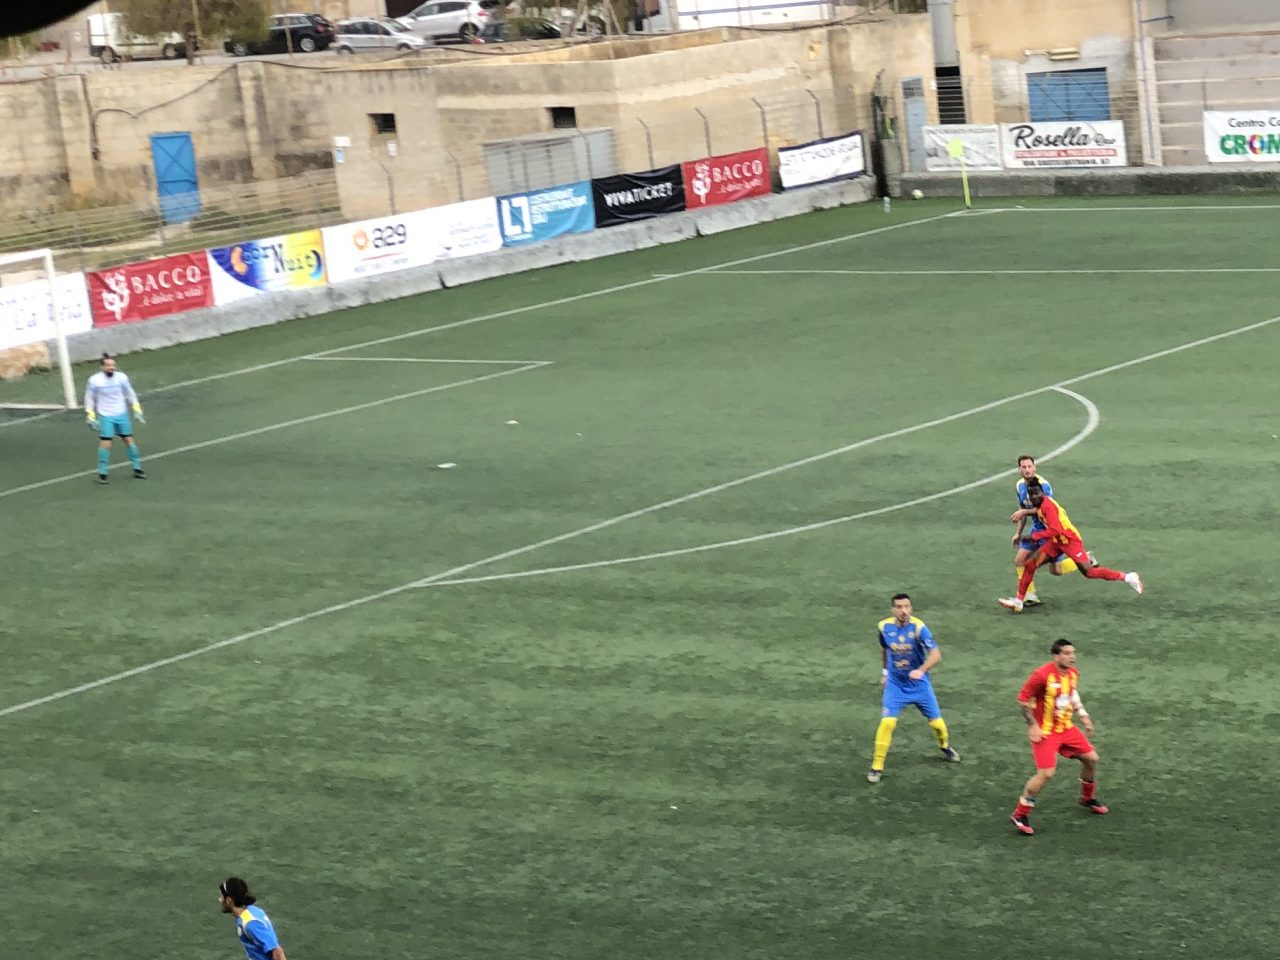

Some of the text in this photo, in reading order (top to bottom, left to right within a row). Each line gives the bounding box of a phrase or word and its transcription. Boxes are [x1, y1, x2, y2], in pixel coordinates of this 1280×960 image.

[1228, 118, 1266, 128] Centro
[1009, 125, 1090, 149] Rosella
[711, 159, 764, 183] BACCO
[603, 182, 673, 207] VIVATICKET
[131, 265, 201, 294] BACCO
